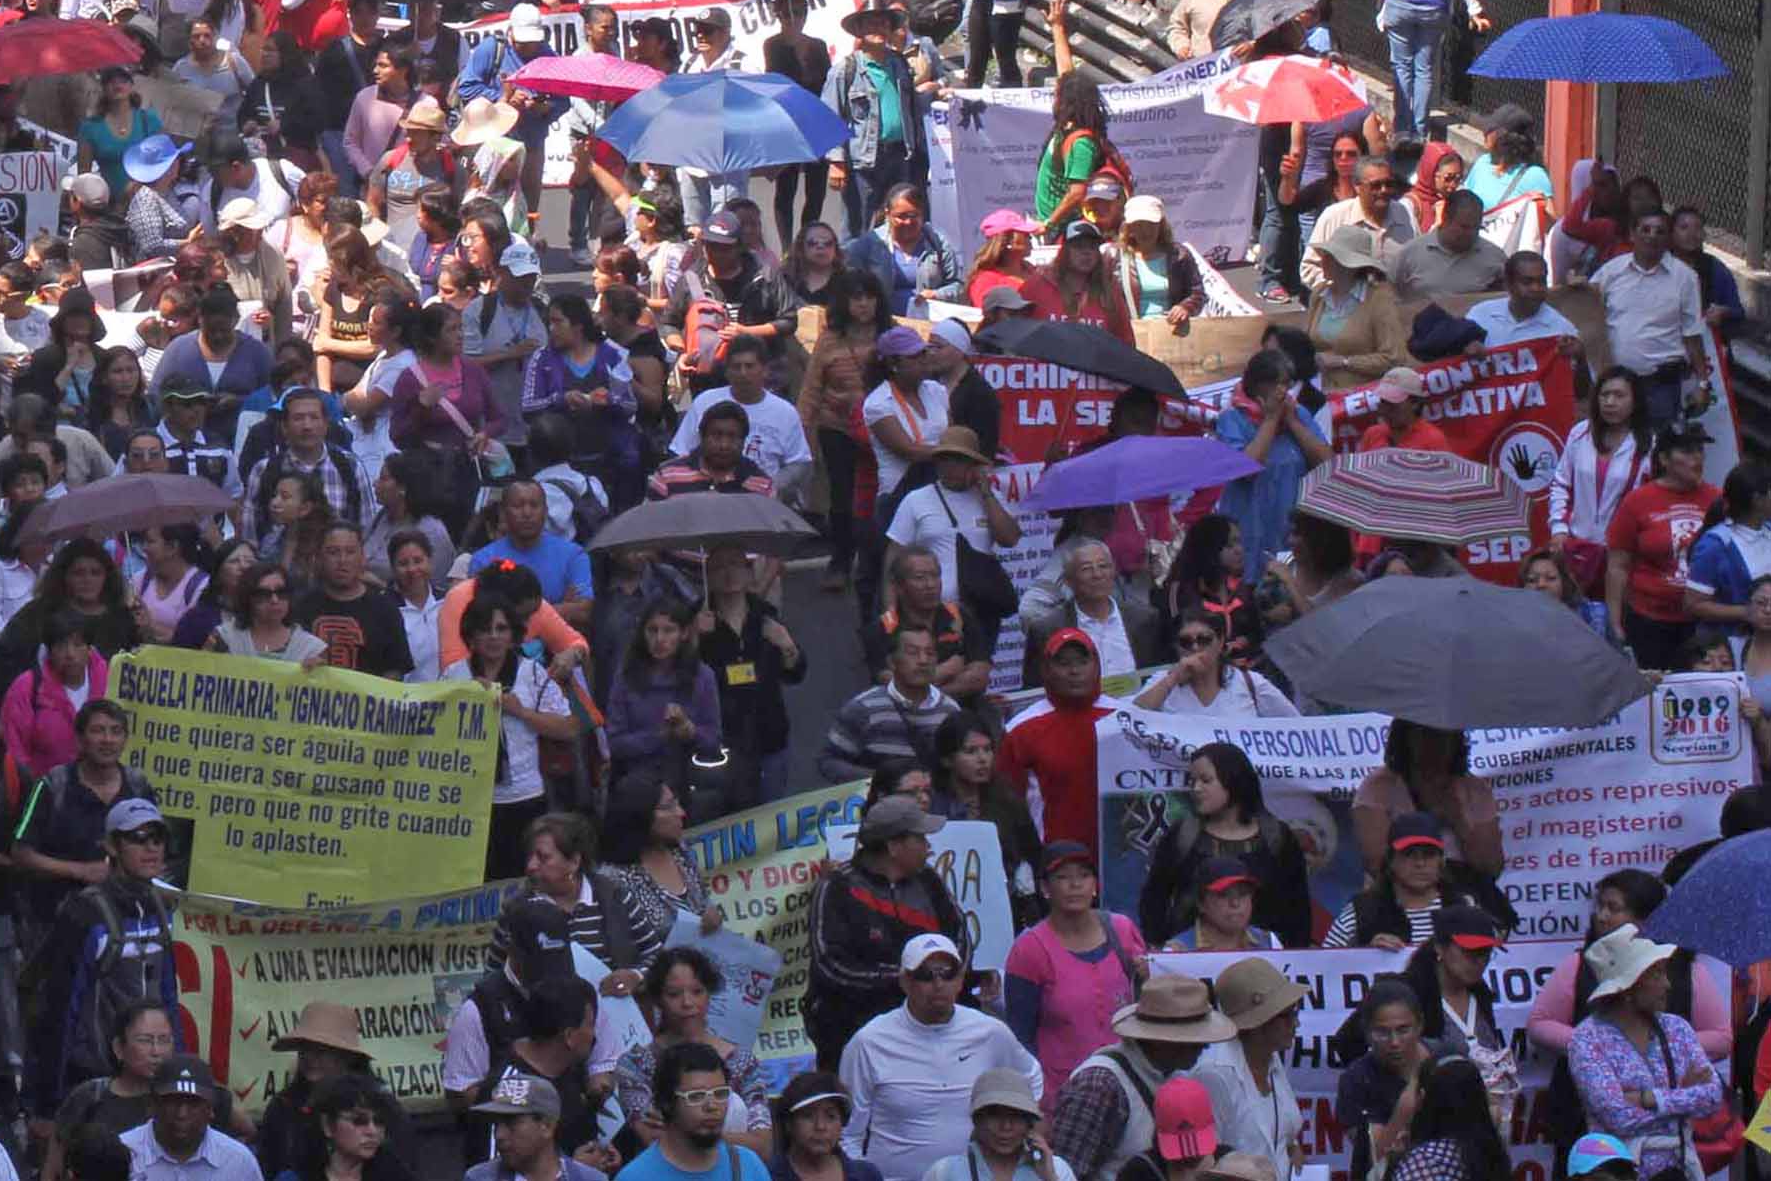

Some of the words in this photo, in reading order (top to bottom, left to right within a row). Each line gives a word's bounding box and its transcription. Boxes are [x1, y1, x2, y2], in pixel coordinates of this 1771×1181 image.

[1017, 399, 1057, 426] LA
[1467, 534, 1532, 565] SEP
[117, 662, 188, 711] ESCUELA
[193, 672, 280, 722] PRIMARIA:
[284, 685, 361, 730] "IGNACIO
[363, 691, 447, 739] RAMÍREZ"
[457, 699, 488, 742] T.M.
[1663, 715, 1730, 736] 2016
[144, 716, 185, 749] que
[188, 722, 254, 756] quiera
[262, 734, 295, 757] ser
[303, 733, 366, 767] águila
[373, 744, 411, 776] que
[417, 745, 478, 780] vuele,
[1240, 728, 1347, 759] PERSONAL
[1298, 768, 1310, 779] A
[1315, 767, 1346, 781] LAS
[1473, 735, 1638, 770] GUBERNAMENTALES
[130, 747, 146, 771] el
[153, 754, 190, 784] que
[198, 758, 264, 791] quiera
[271, 769, 303, 793] ser
[312, 774, 386, 803] gusano
[393, 780, 431, 807] que
[439, 784, 462, 805] se
[1529, 784, 1594, 810] actos
[1602, 776, 1740, 804] represivos
[209, 794, 256, 828] pero
[264, 801, 301, 832] que
[309, 805, 334, 823] no
[340, 804, 390, 832] grite
[397, 811, 473, 839] cuando
[1513, 819, 1532, 841] el
[1540, 811, 1684, 840] magisterio
[225, 823, 244, 848] lo
[251, 826, 349, 859] aplasten.
[1547, 849, 1580, 869] de
[737, 868, 754, 892] Y
[732, 896, 779, 924] LOS
[254, 952, 267, 982] A
[270, 947, 312, 982] UNA
[267, 1010, 282, 1042] A
